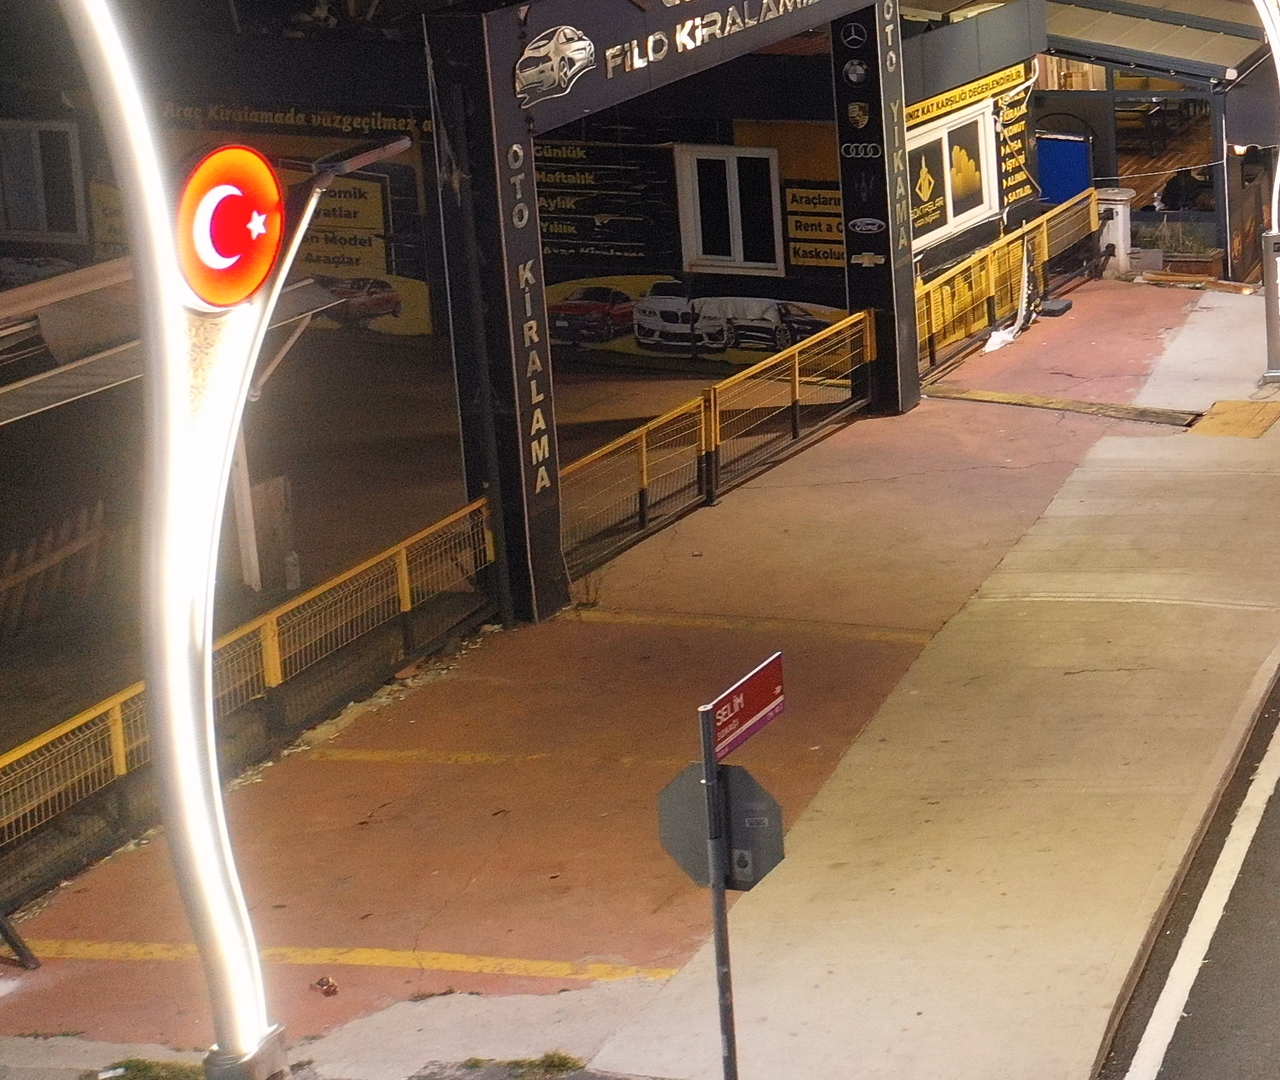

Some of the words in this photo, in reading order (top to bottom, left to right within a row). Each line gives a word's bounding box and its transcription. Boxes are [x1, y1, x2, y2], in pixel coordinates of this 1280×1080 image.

[883, 0, 897, 73] OTO
[890, 99, 909, 251] YIKAMA
[507, 143, 530, 230] OTO
[794, 220, 823, 232] Rent
[826, 223, 834, 233] a
